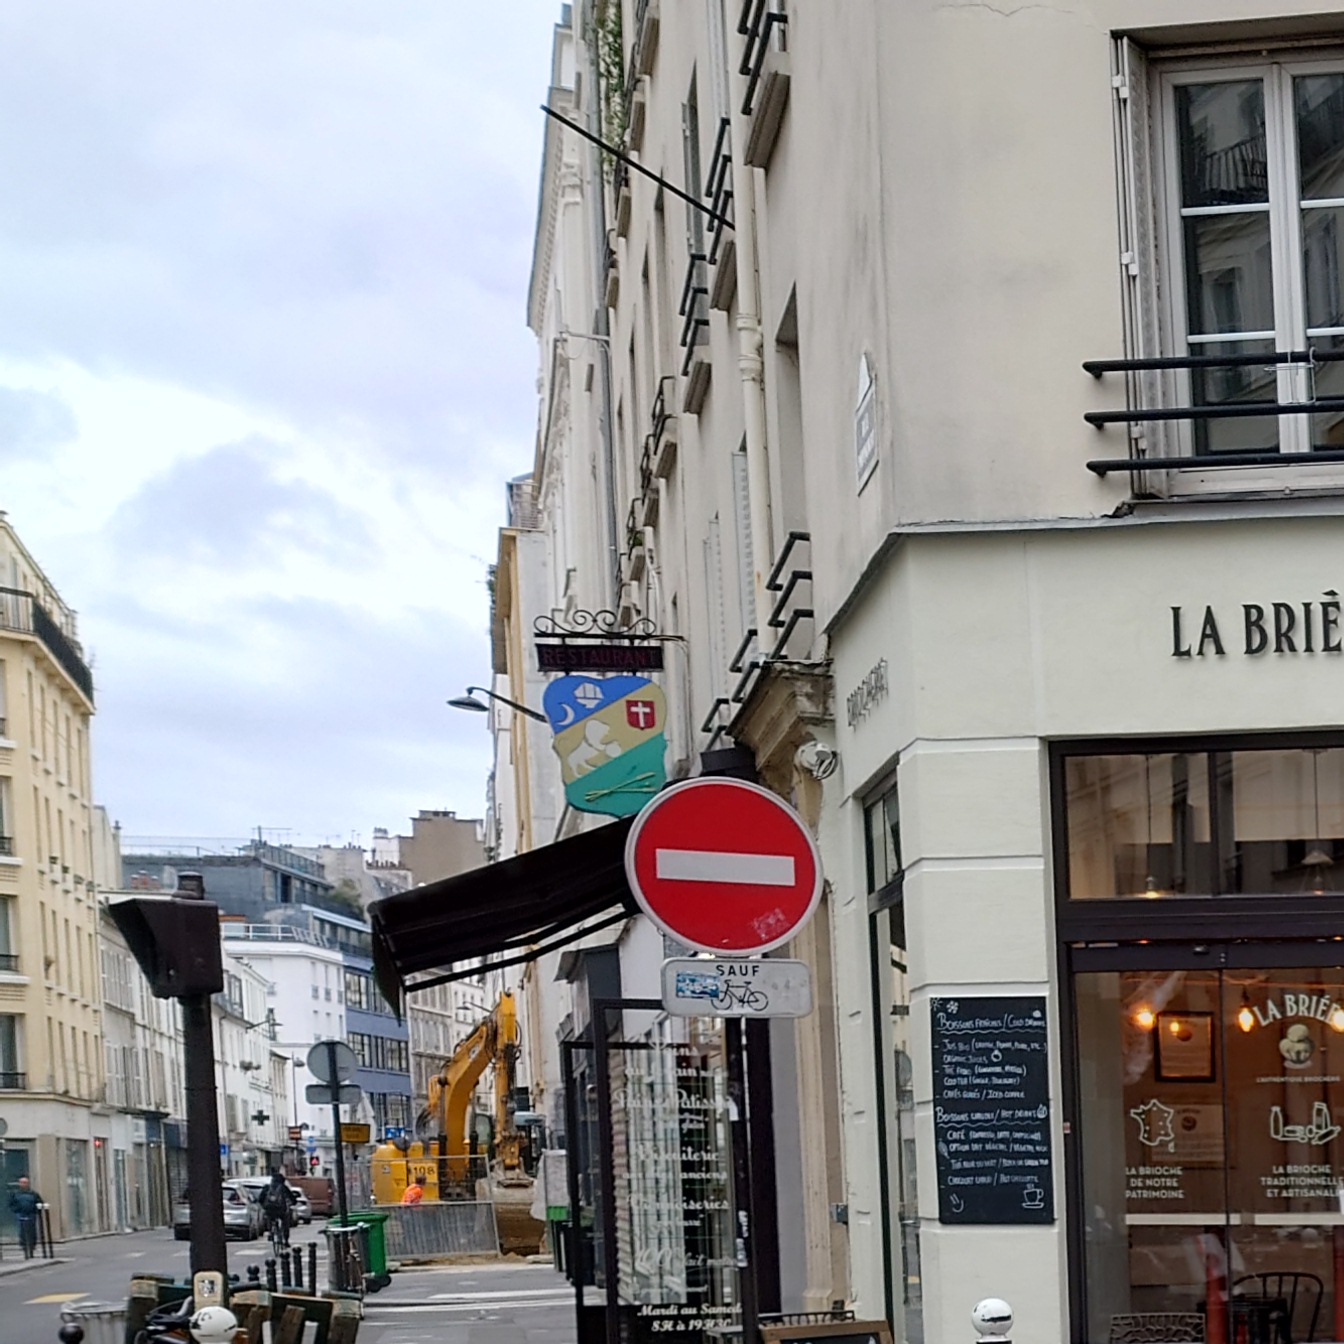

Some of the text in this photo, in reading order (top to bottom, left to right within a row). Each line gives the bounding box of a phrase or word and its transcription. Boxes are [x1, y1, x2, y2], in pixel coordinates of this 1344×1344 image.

[1170, 604, 1226, 657] LA
[543, 647, 657, 666] RESTAURANT
[716, 964, 760, 977] SAUF
[1252, 999, 1282, 1027] LA
[1125, 1166, 1183, 1175] LA BRIOCHE
[1272, 1164, 1331, 1174] LA BRIOCHE
[1130, 1178, 1178, 1187] DE NOTRE
[1260, 1176, 1344, 1186] TRADITIONNELLE
[1125, 1189, 1185, 1199] PATRIMOINE
[1266, 1188, 1279, 1197] ET
[637, 1304, 678, 1316] Mardi
[680, 1306, 698, 1316] au
